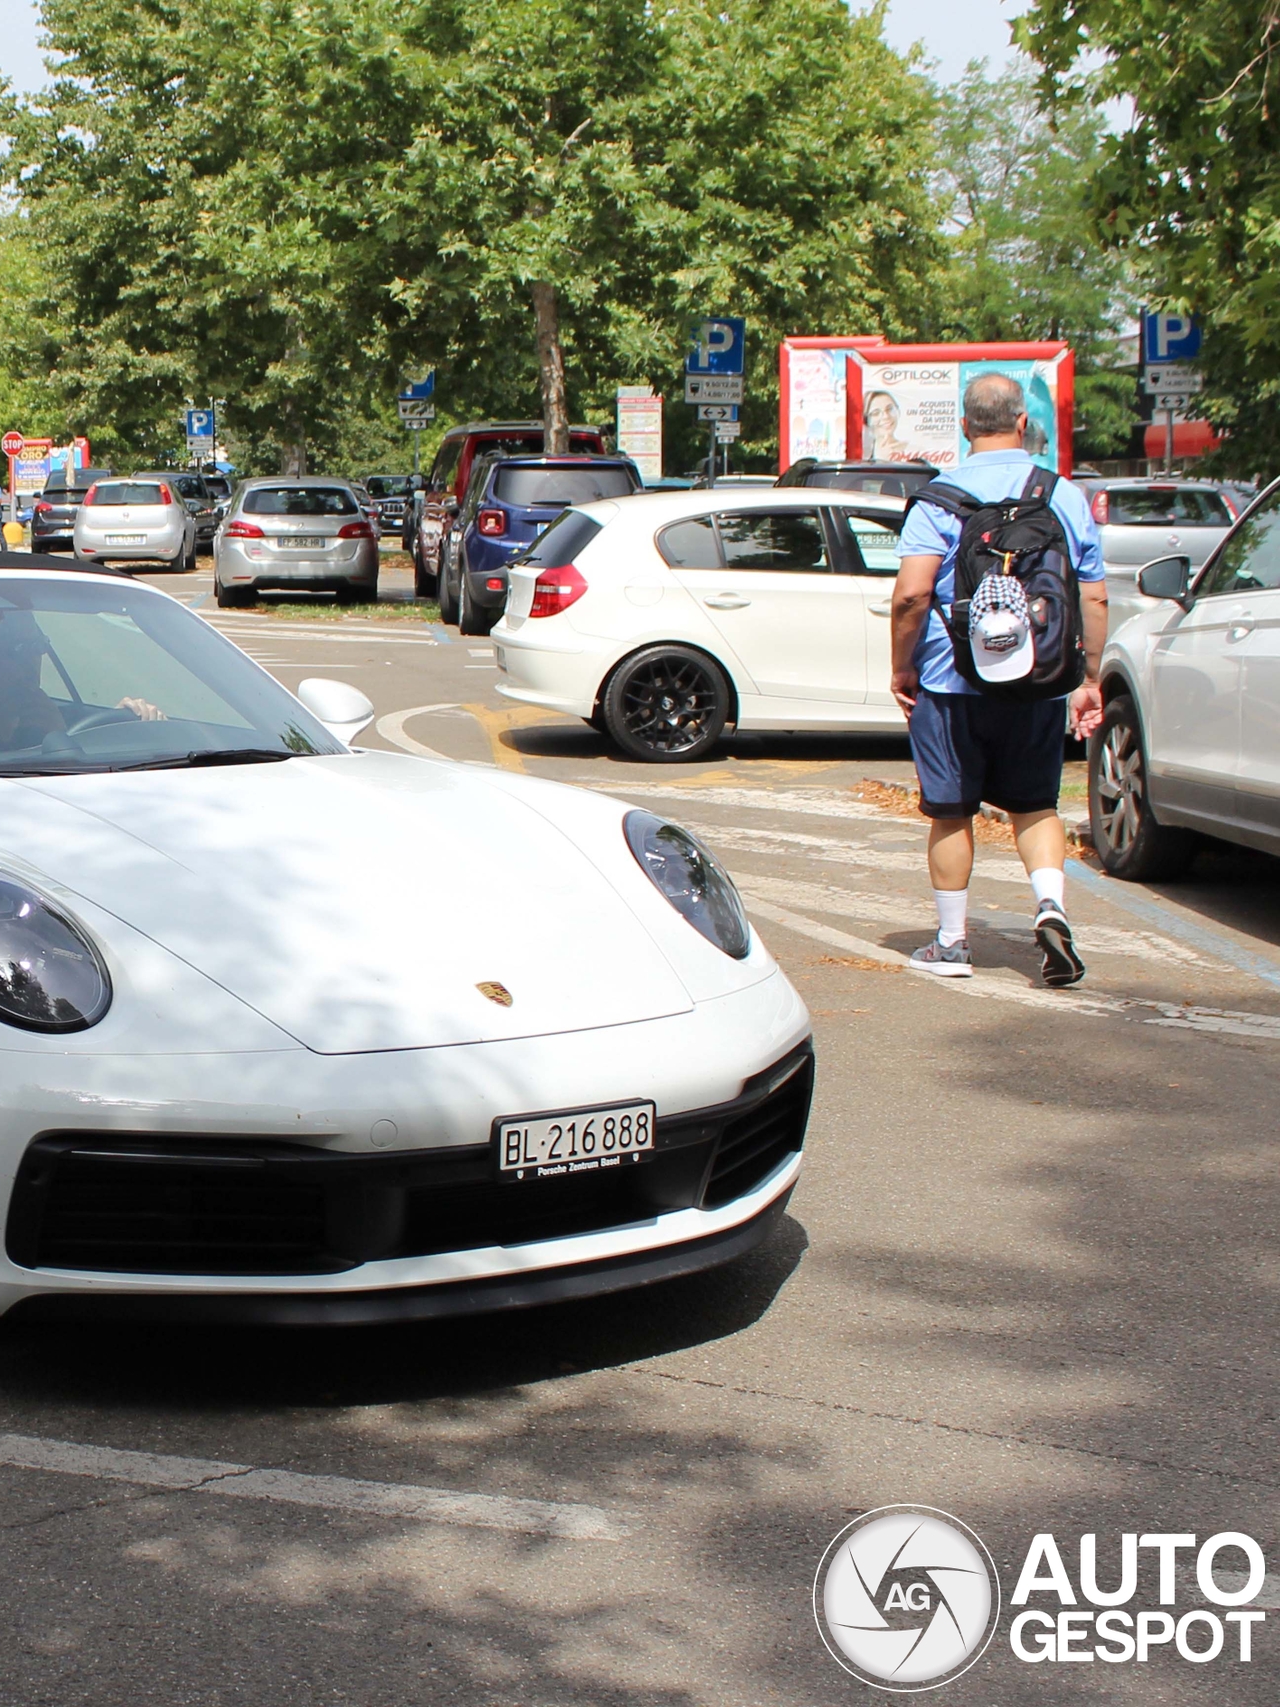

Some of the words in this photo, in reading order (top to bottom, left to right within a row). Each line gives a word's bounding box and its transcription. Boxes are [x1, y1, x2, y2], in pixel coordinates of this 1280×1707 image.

[1156, 311, 1191, 357] P
[698, 322, 734, 368] P
[882, 368, 953, 380] OPTILOOK
[919, 401, 956, 409] ACQUISTA
[191, 412, 208, 434] P
[3, 439, 23, 449] STOP
[20, 451, 43, 460] ORO
[537, 1164, 567, 1177] Porsche
[569, 1159, 599, 1172] Zentrum
[600, 1156, 620, 1168] Basel
